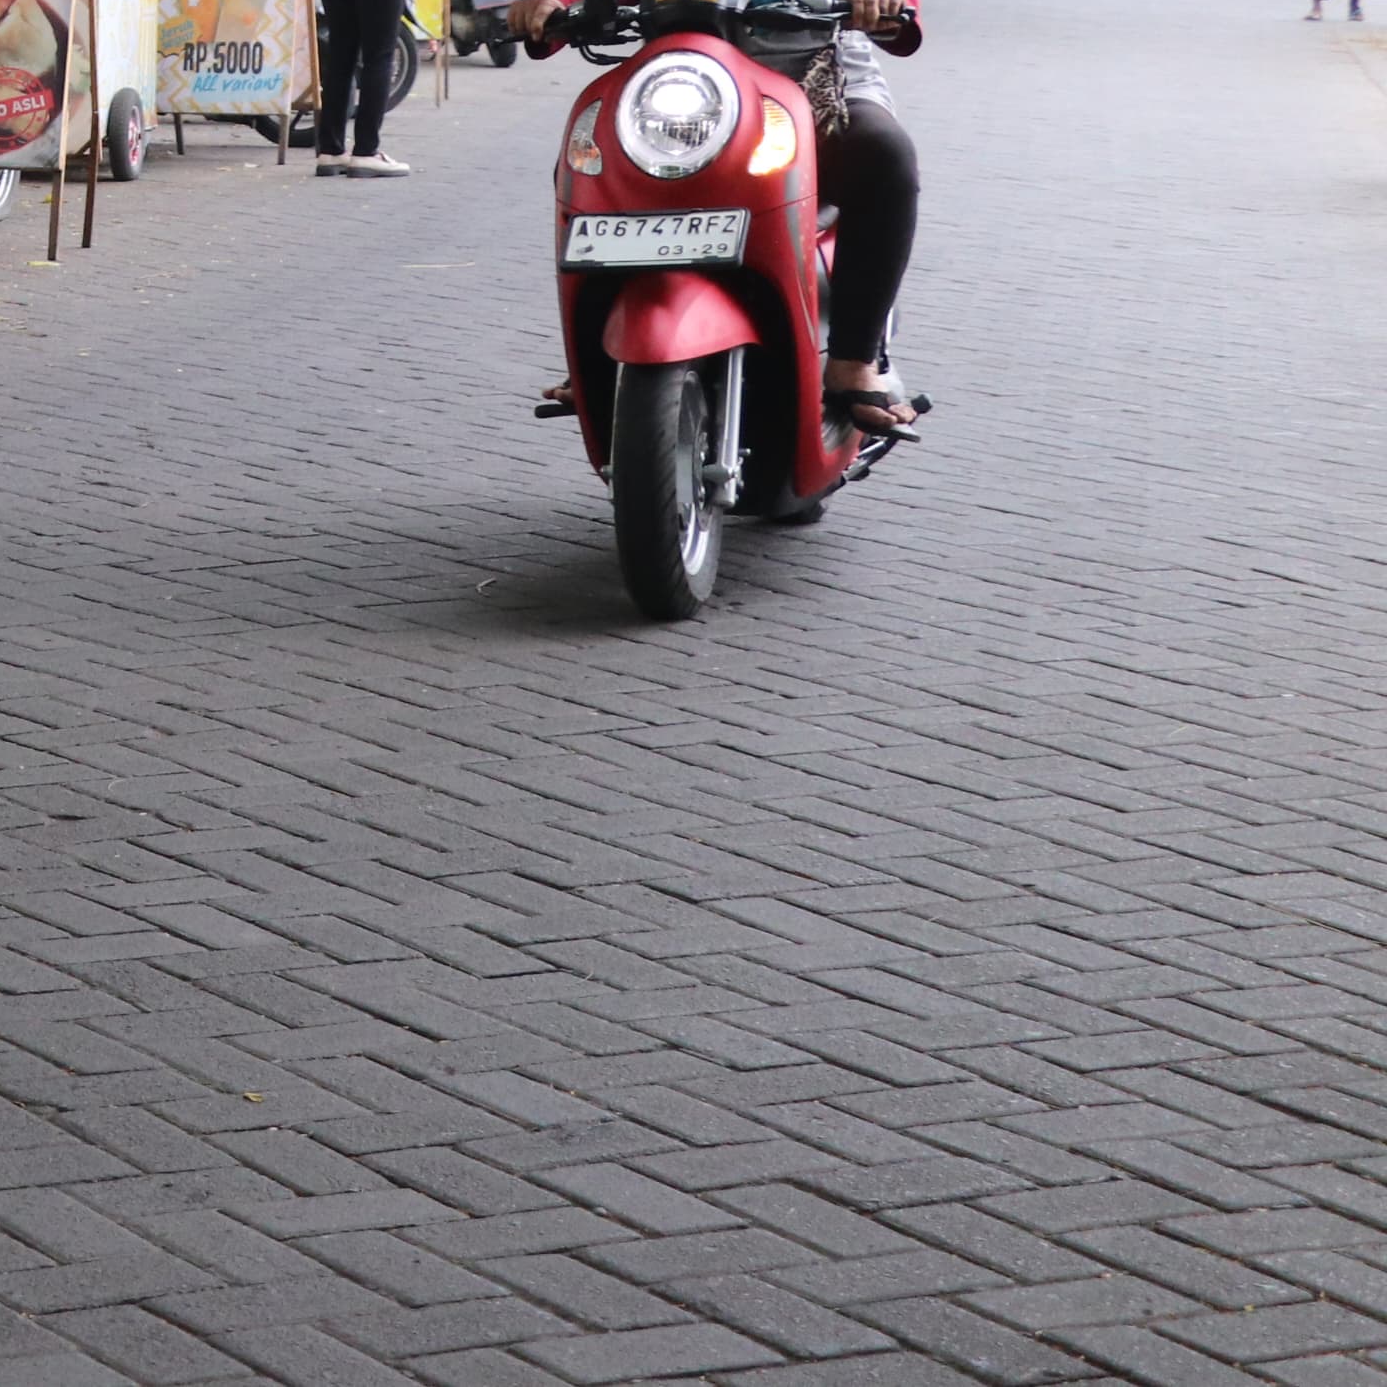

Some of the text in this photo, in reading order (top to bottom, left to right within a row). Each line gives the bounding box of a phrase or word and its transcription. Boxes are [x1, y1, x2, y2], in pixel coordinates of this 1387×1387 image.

[184, 42, 264, 74] RP.5000
[223, 73, 283, 91] variant
[12, 95, 45, 113] ASLI
